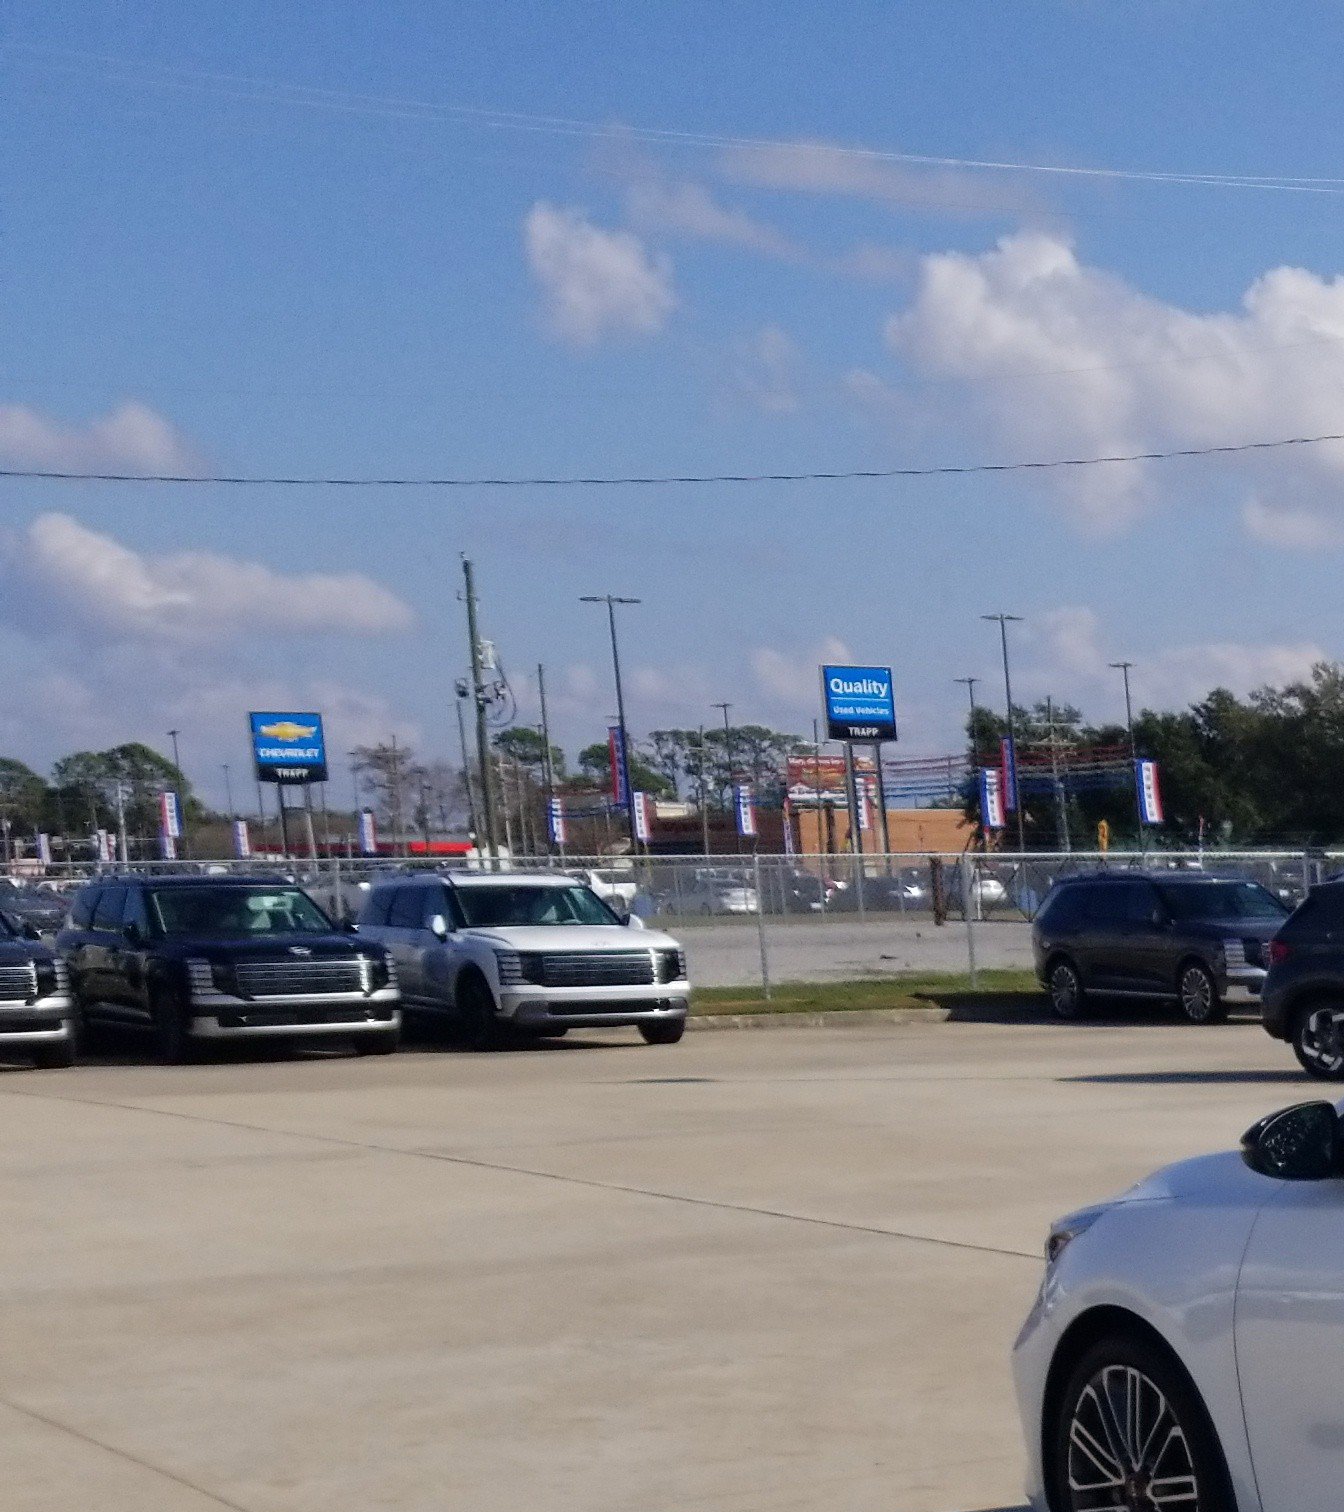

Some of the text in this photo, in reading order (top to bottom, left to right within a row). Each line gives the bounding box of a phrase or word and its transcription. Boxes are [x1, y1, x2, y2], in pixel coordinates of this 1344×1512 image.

[830, 678, 888, 697] Quality
[833, 706, 854, 714] Used
[848, 726, 879, 737] TRAPP
[276, 768, 309, 778] TRAPP
